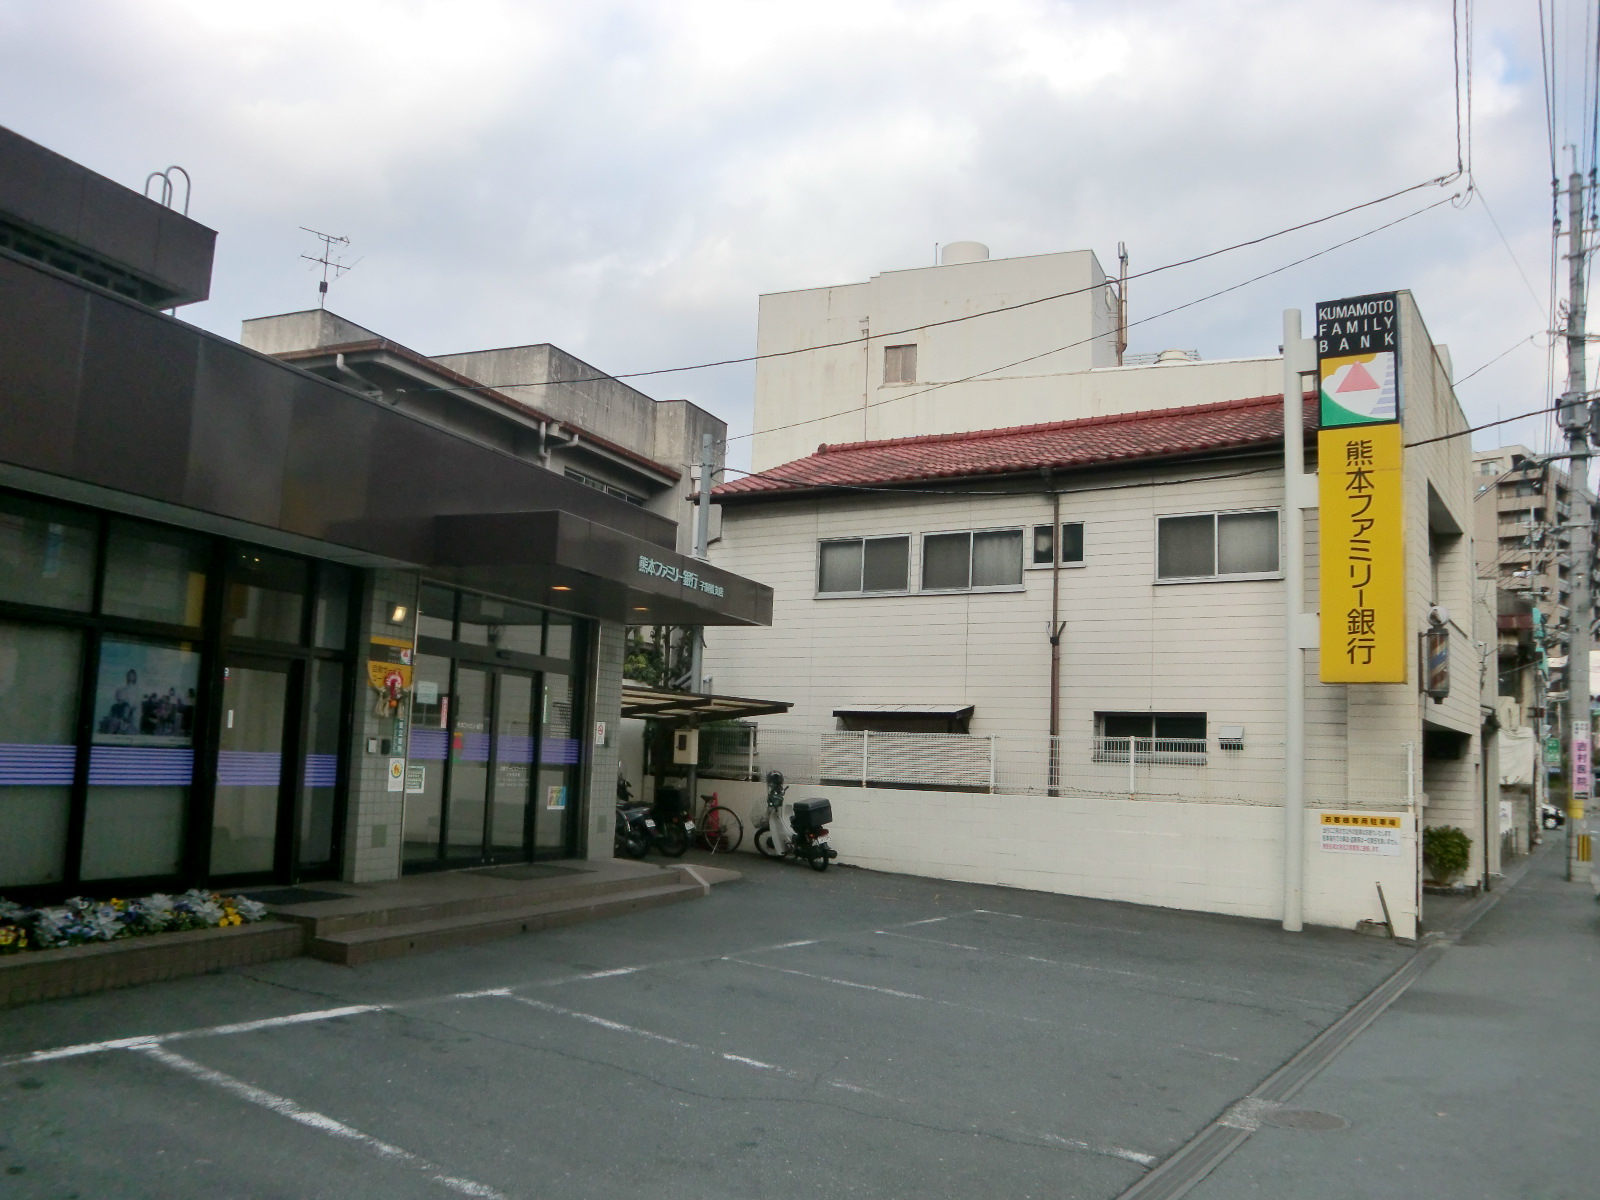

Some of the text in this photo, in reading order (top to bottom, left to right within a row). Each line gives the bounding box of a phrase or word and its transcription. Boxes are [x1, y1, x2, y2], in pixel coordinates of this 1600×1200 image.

[1318, 299, 1394, 322] KUMAMOTO
[1319, 316, 1394, 337] FAMILY
[1319, 331, 1394, 353] BANK
[1345, 439, 1376, 665] 熊本ファミリー銀行
